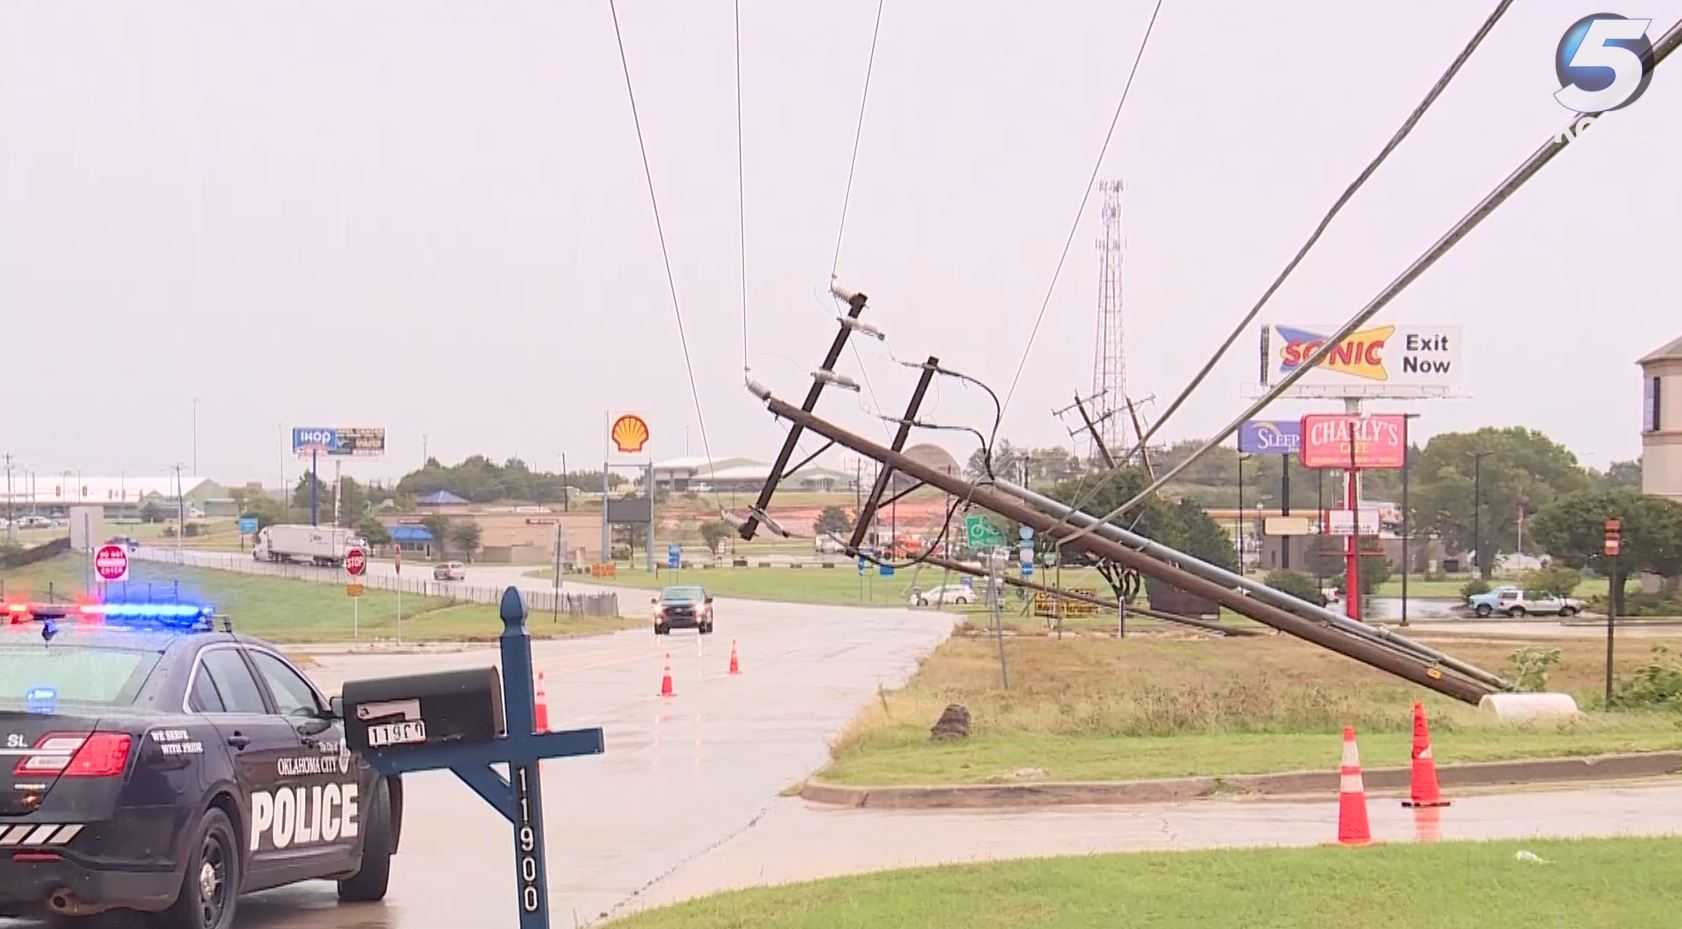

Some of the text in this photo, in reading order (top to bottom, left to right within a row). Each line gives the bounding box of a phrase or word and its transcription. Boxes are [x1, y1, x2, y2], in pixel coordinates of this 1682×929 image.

[1282, 338, 1385, 366] SONIC
[1406, 334, 1449, 352] Exit
[1403, 356, 1451, 374] Now
[1311, 419, 1399, 448] CHARLY'S
[347, 556, 363, 568] STOP
[277, 756, 337, 776] OKLAHOMA CITY
[250, 783, 359, 851] POLICE
[519, 767, 538, 911] 11900
